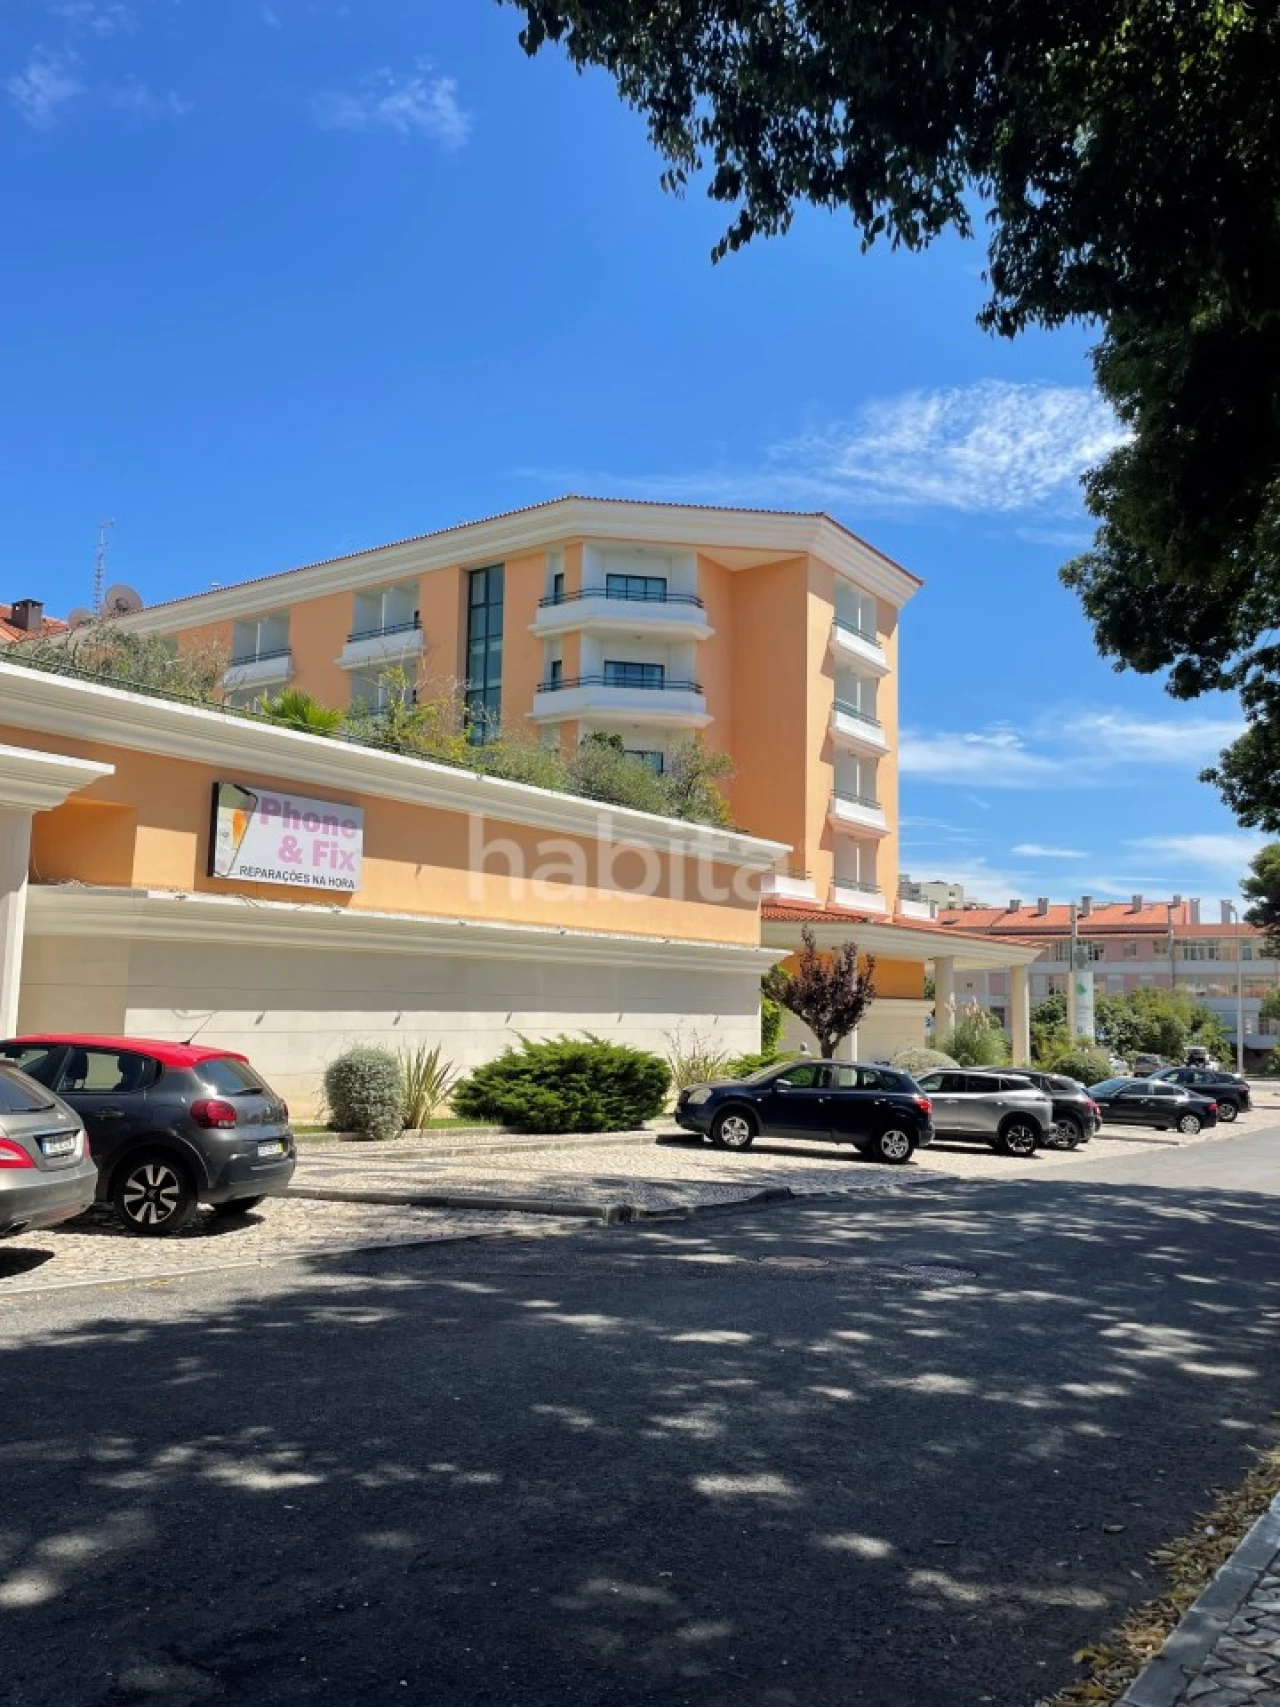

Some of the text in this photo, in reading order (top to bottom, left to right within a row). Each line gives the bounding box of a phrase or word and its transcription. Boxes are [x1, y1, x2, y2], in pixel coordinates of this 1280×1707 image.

[260, 797, 358, 839] Phone
[277, 835, 355, 871] & Fix
[239, 865, 355, 889] REPARAÇÕES NA HORA
